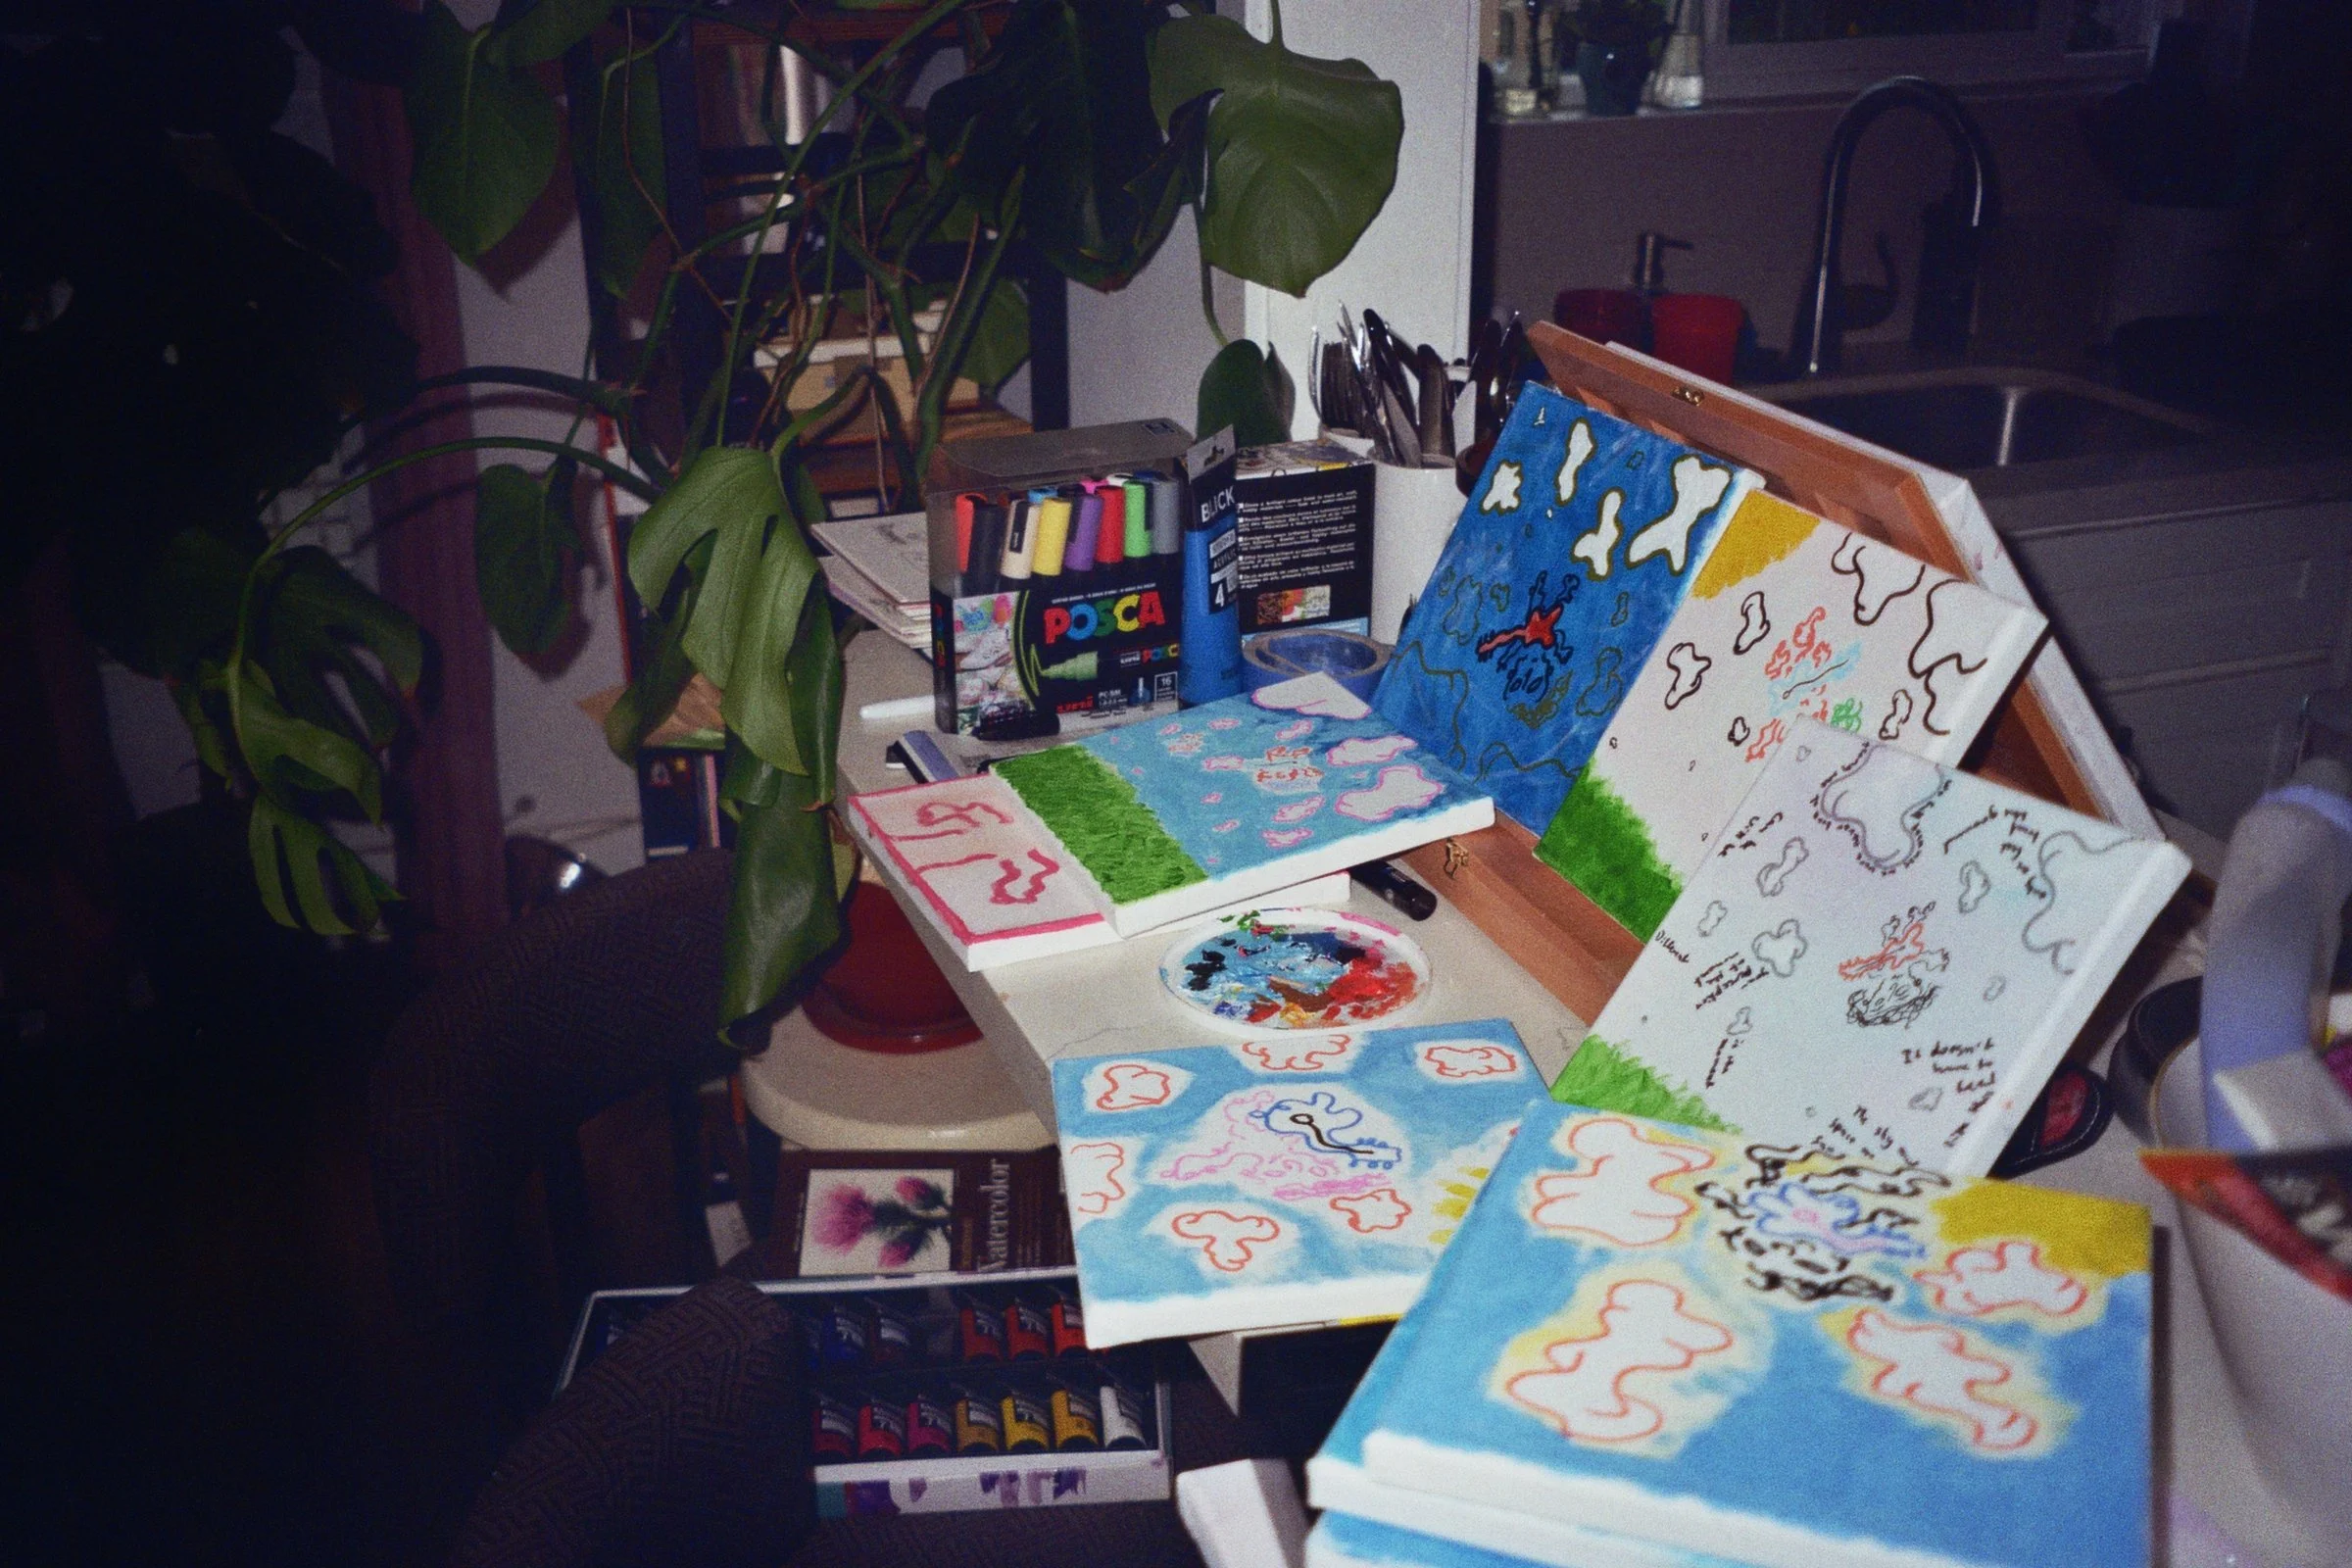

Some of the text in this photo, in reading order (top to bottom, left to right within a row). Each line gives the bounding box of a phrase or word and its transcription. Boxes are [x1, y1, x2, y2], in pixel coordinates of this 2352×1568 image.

[1200, 485, 1235, 523] BLICK
[1214, 583, 1224, 608] 4
[1043, 591, 1165, 644] POSCA
[1931, 1037, 1995, 1058] doesn't
